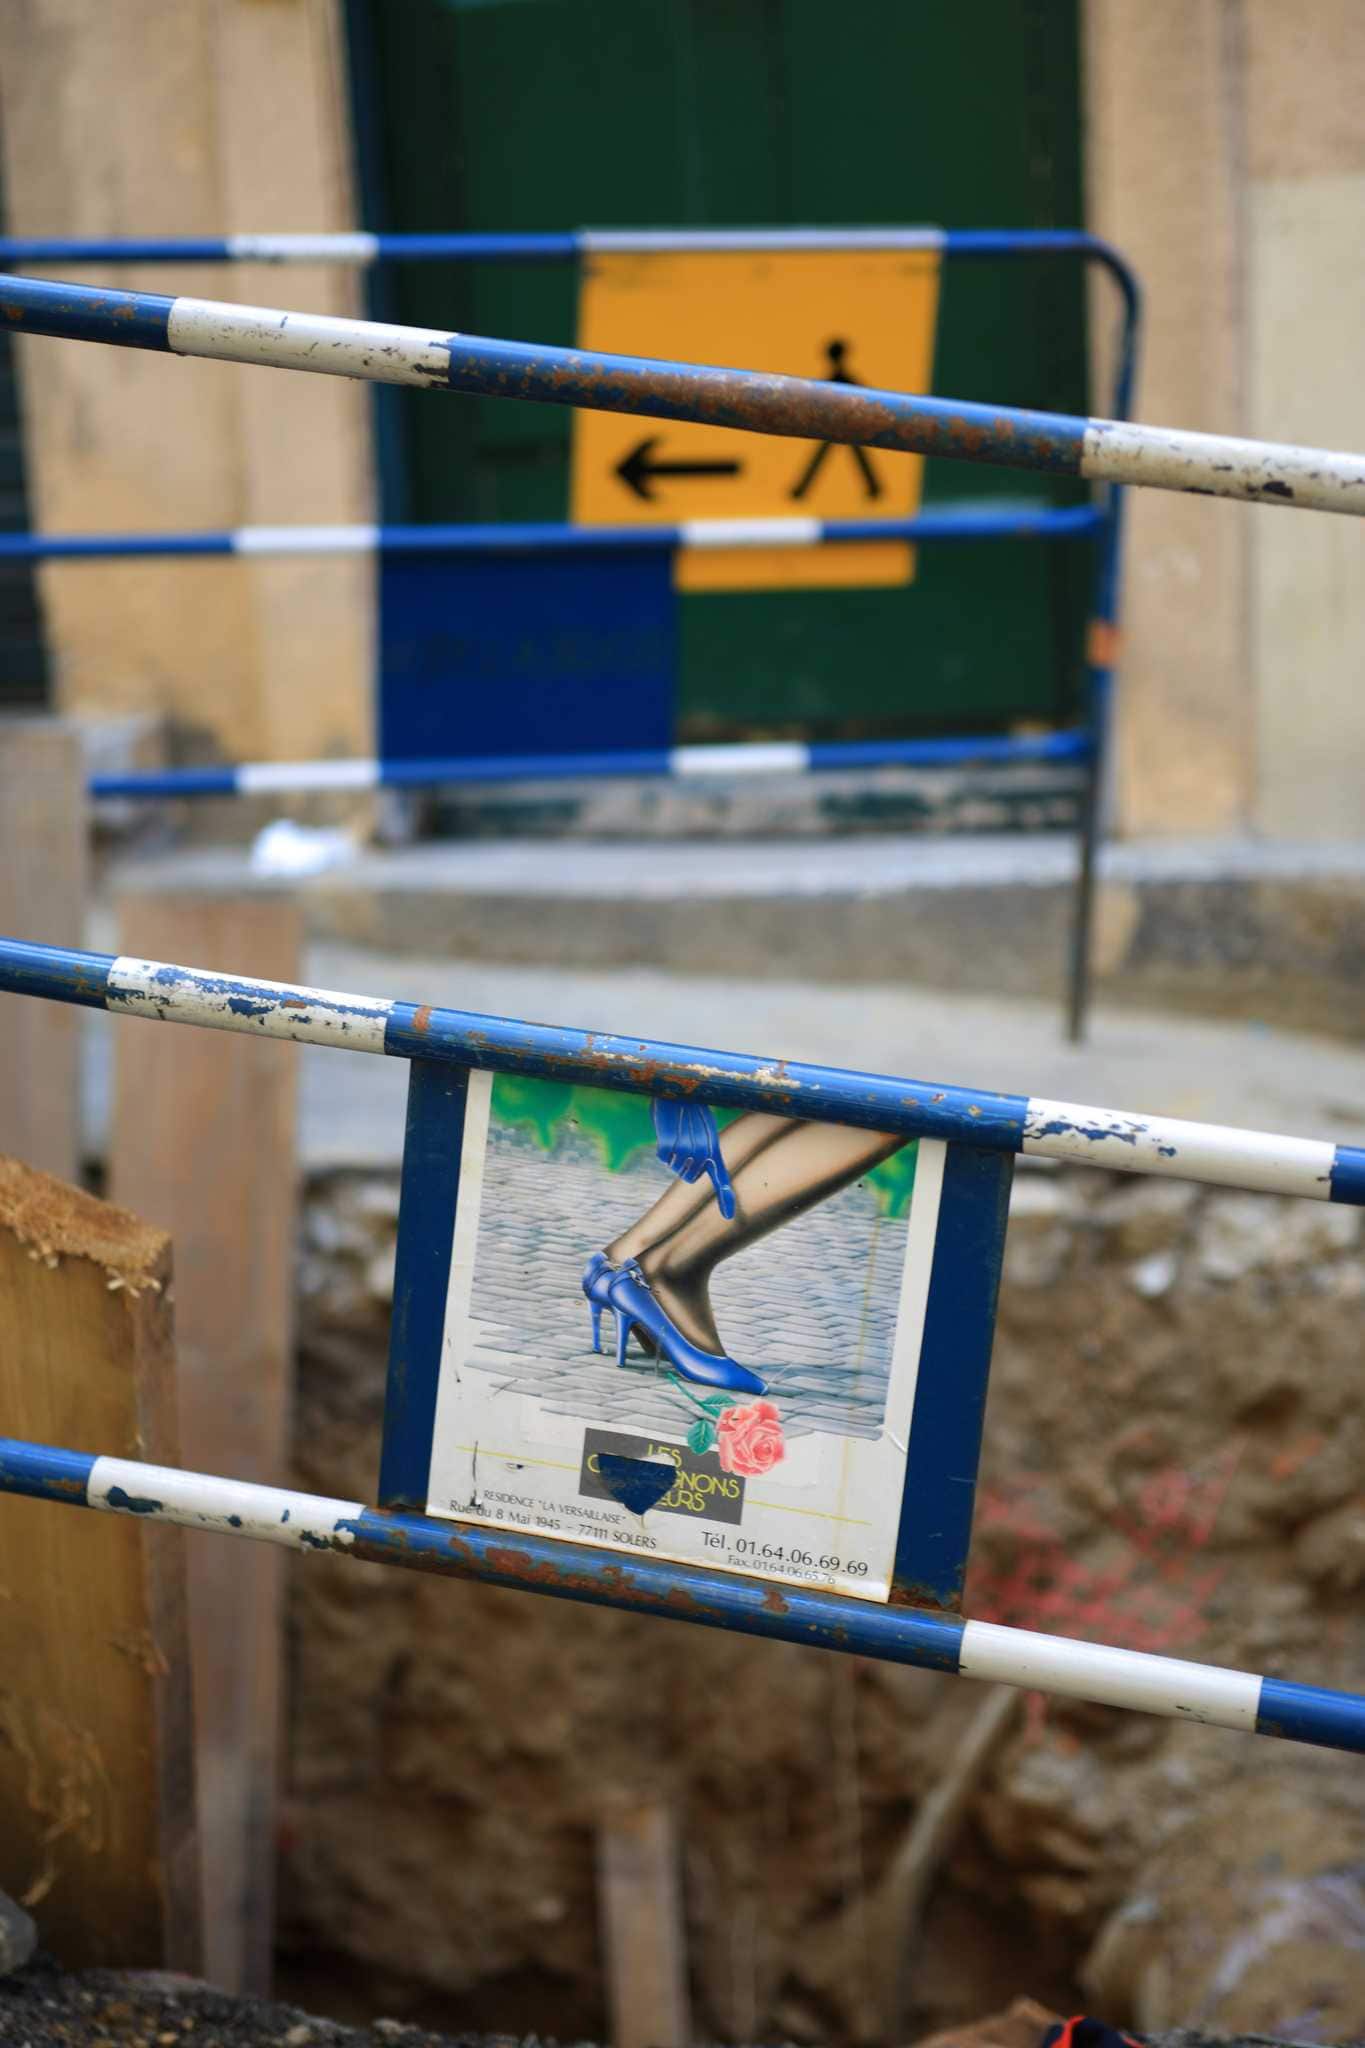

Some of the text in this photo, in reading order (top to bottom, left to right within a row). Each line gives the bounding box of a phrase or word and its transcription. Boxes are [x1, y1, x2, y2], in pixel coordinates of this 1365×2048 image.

[484, 1489, 535, 1508] RESIDENCE
[449, 1499, 473, 1514] Rue
[476, 1502, 492, 1518] du
[495, 1508, 504, 1520] 8
[509, 1511, 530, 1525] Mai
[536, 1516, 560, 1531] 1945
[578, 1523, 608, 1540] 77111
[612, 1530, 657, 1549] SOLERS
[701, 1531, 868, 1576] Tél. 01.64.06.69.69
